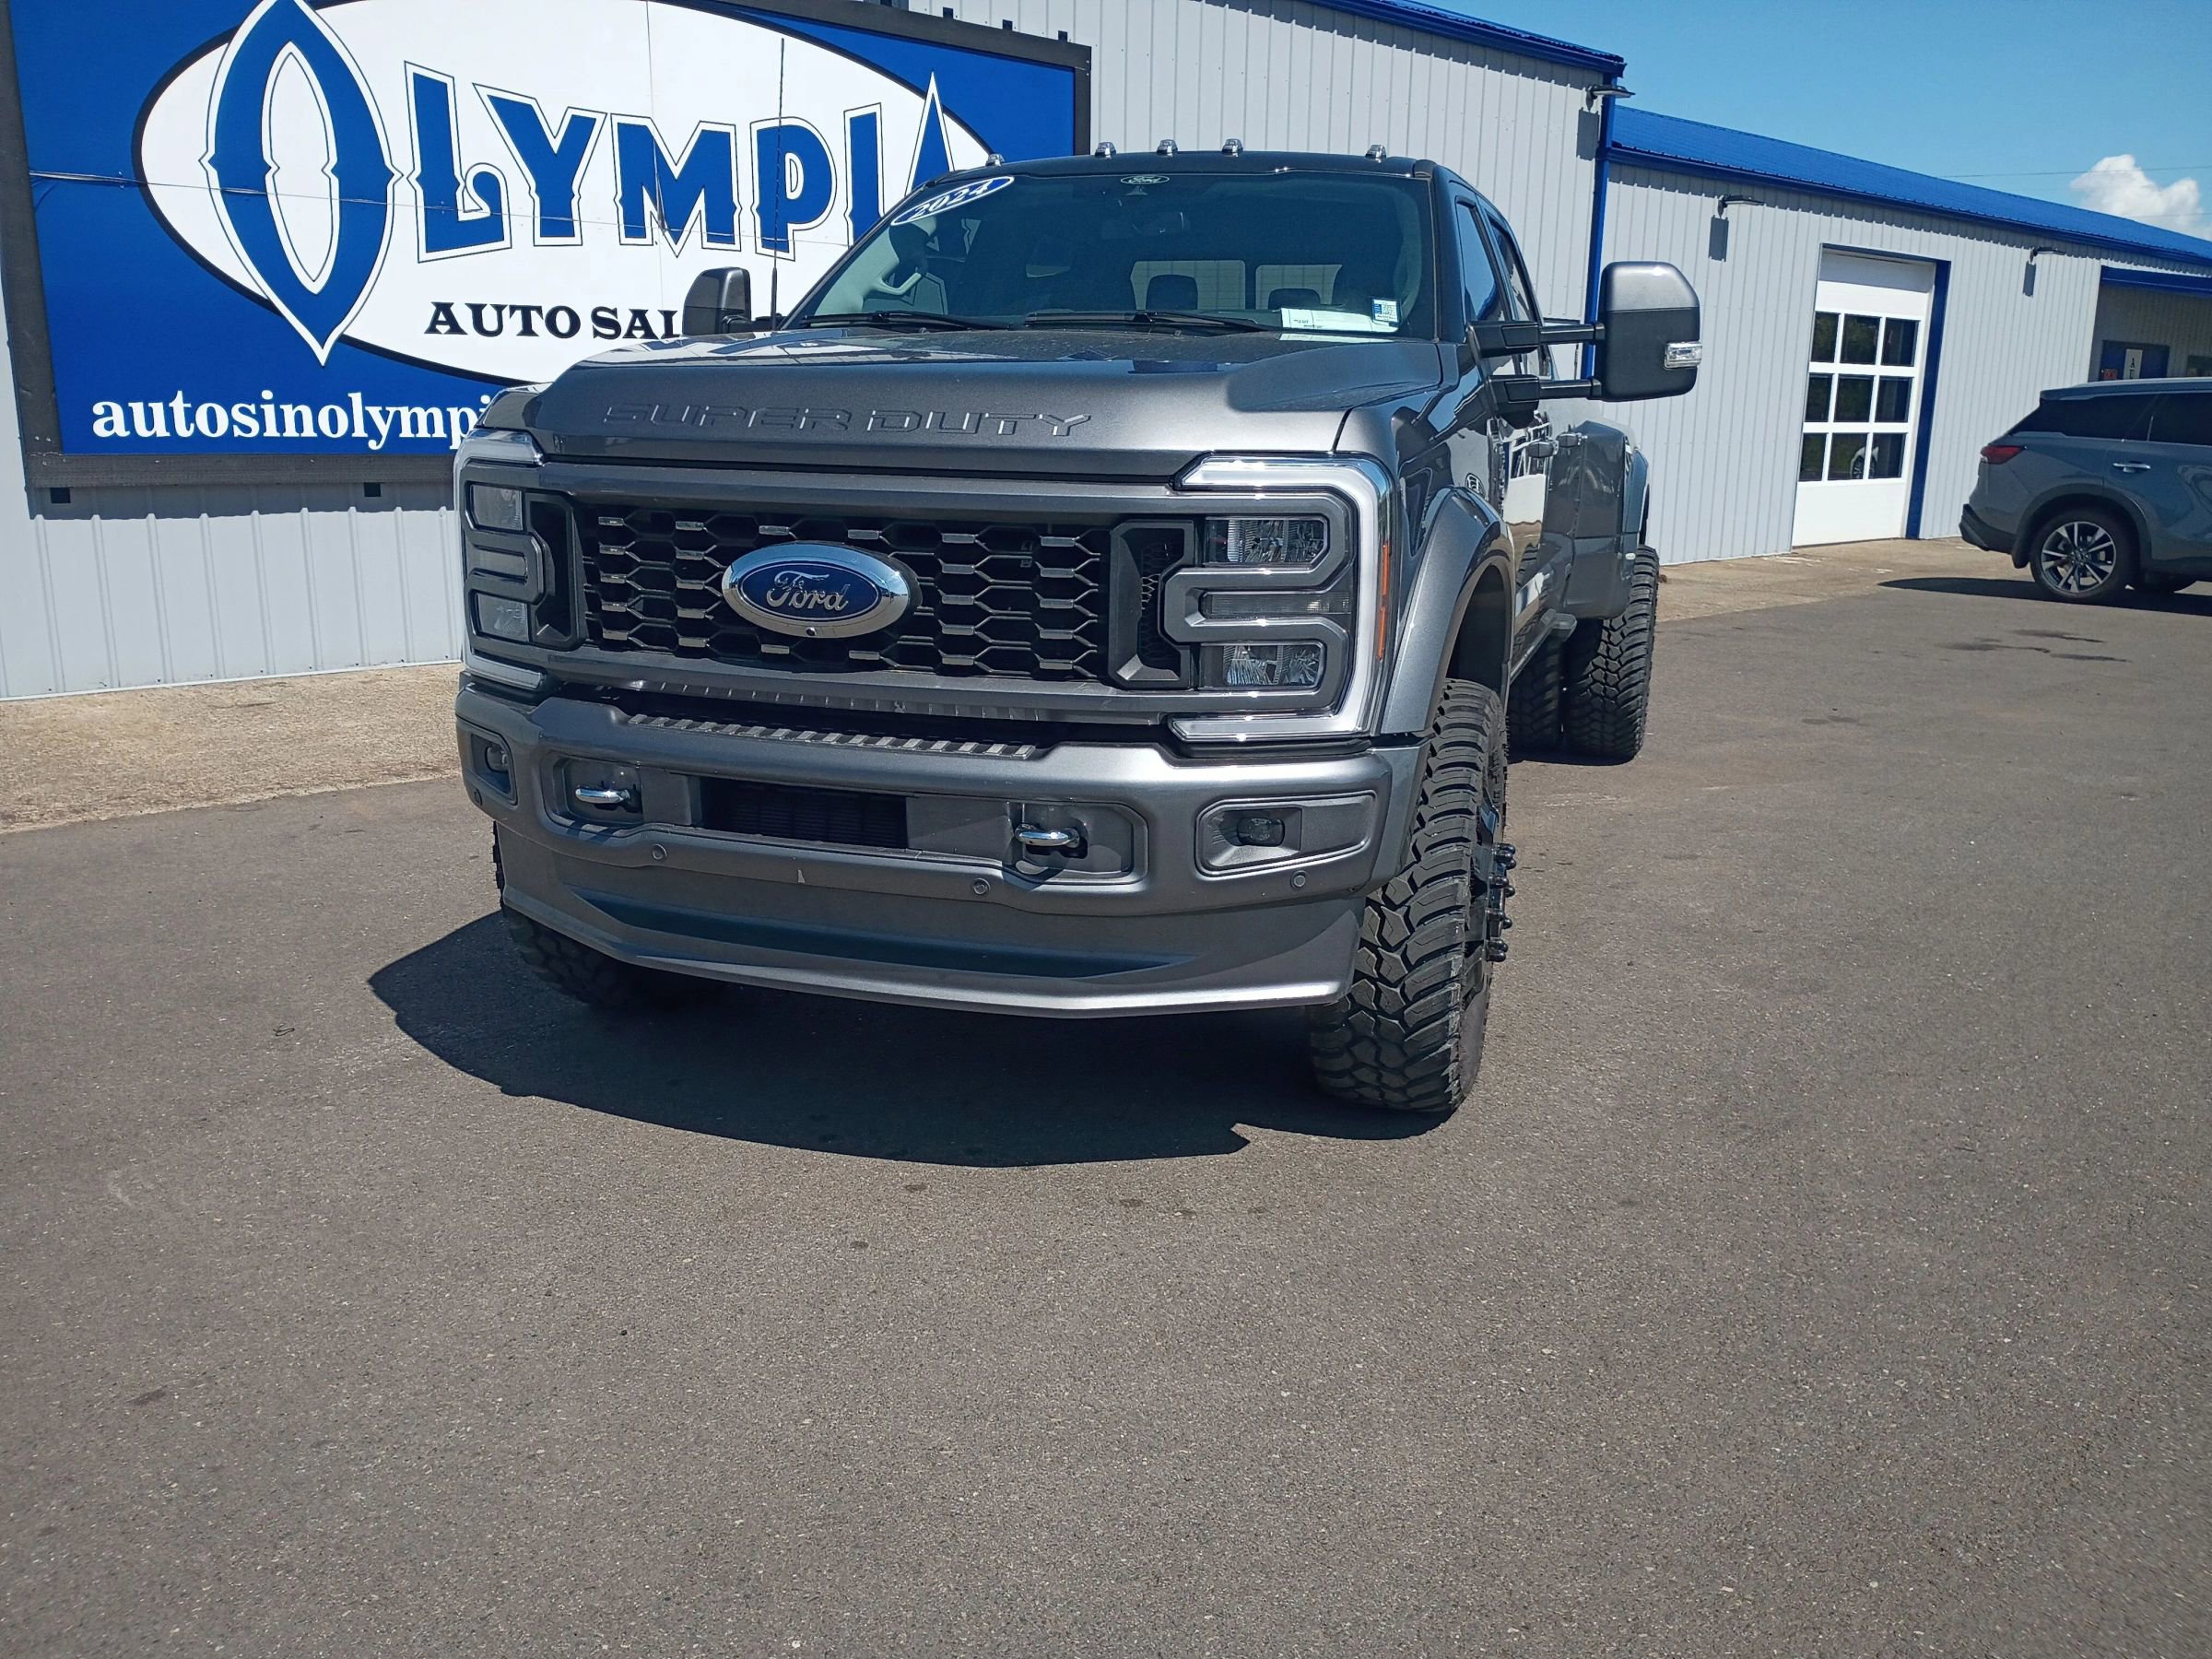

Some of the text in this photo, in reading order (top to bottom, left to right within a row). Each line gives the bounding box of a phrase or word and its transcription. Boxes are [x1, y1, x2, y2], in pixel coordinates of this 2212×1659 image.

[907, 179, 994, 221] 2024
[424, 301, 581, 339] AUTO
[603, 404, 1092, 437] SUPER DUTY
[766, 570, 851, 612] Ford
